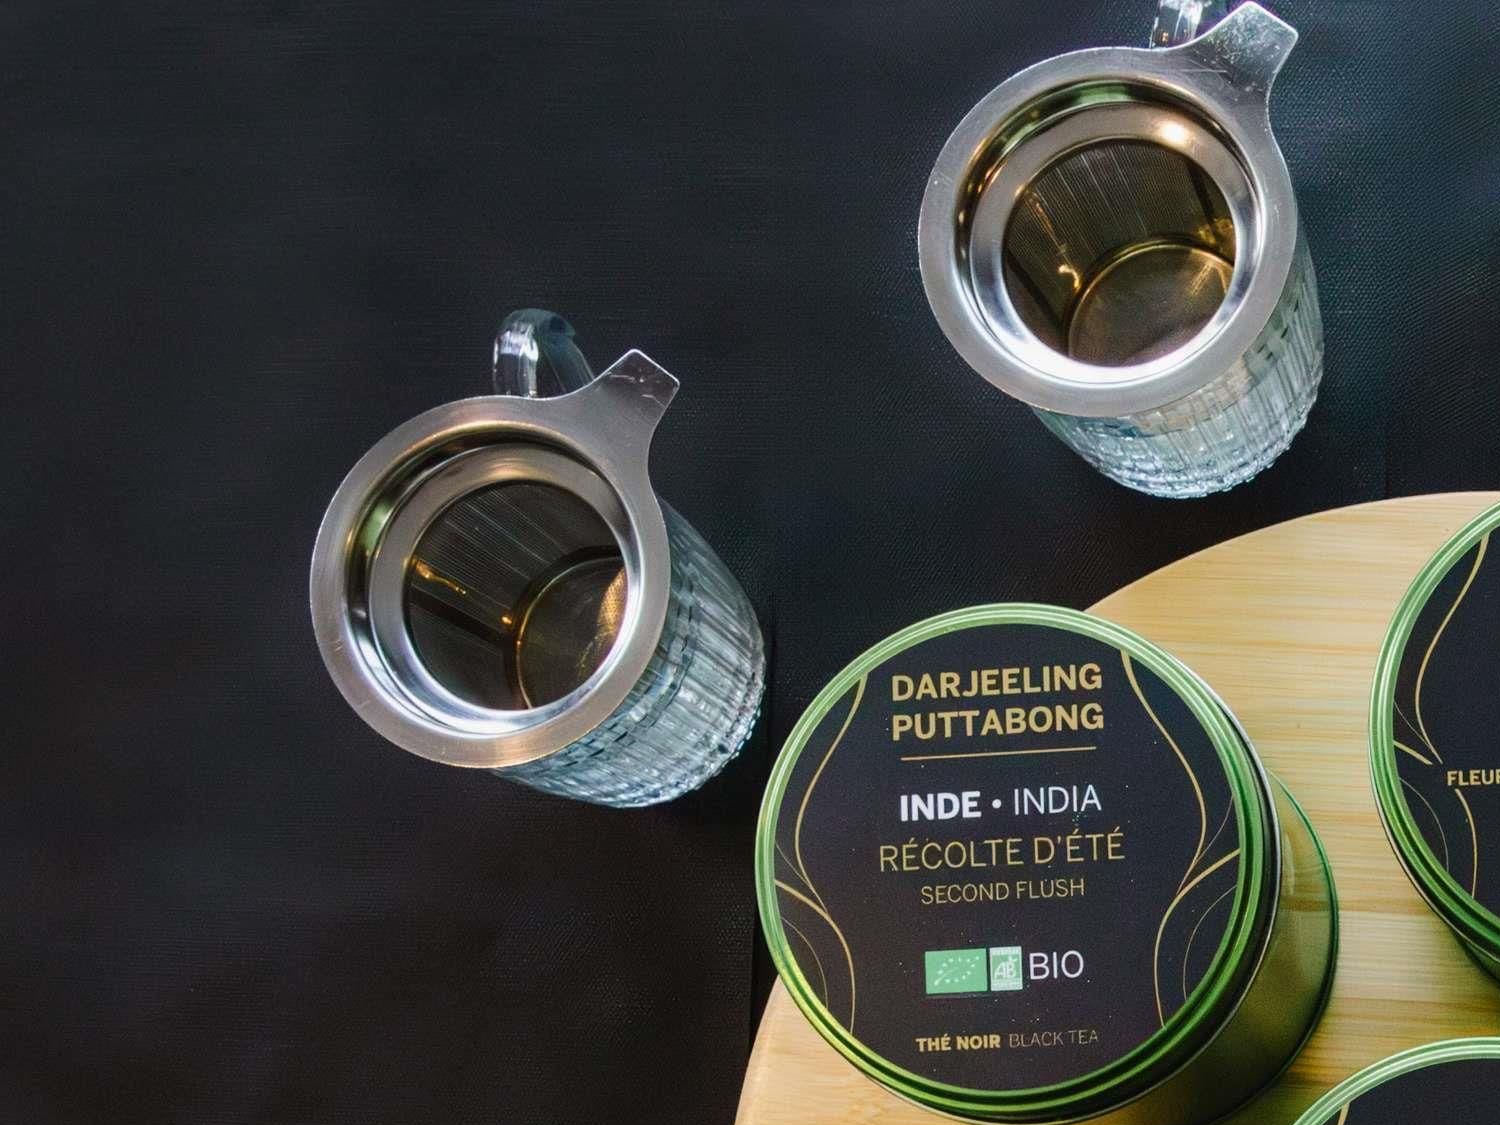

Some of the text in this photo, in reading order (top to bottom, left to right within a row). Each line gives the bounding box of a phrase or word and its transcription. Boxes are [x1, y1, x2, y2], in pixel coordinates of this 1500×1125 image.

[893, 663, 1102, 701] DARJEELING
[893, 703, 1104, 740] PUTTABONG
[901, 785, 1101, 821] INDE INDIA
[880, 826, 1124, 872] RÉCOLTE D'ÉTÉ
[921, 878, 1084, 904] SECOND FLUSH
[1030, 951, 1084, 979] BIO
[916, 1030, 1098, 1052] THÉ NOIR BLACK TEA
